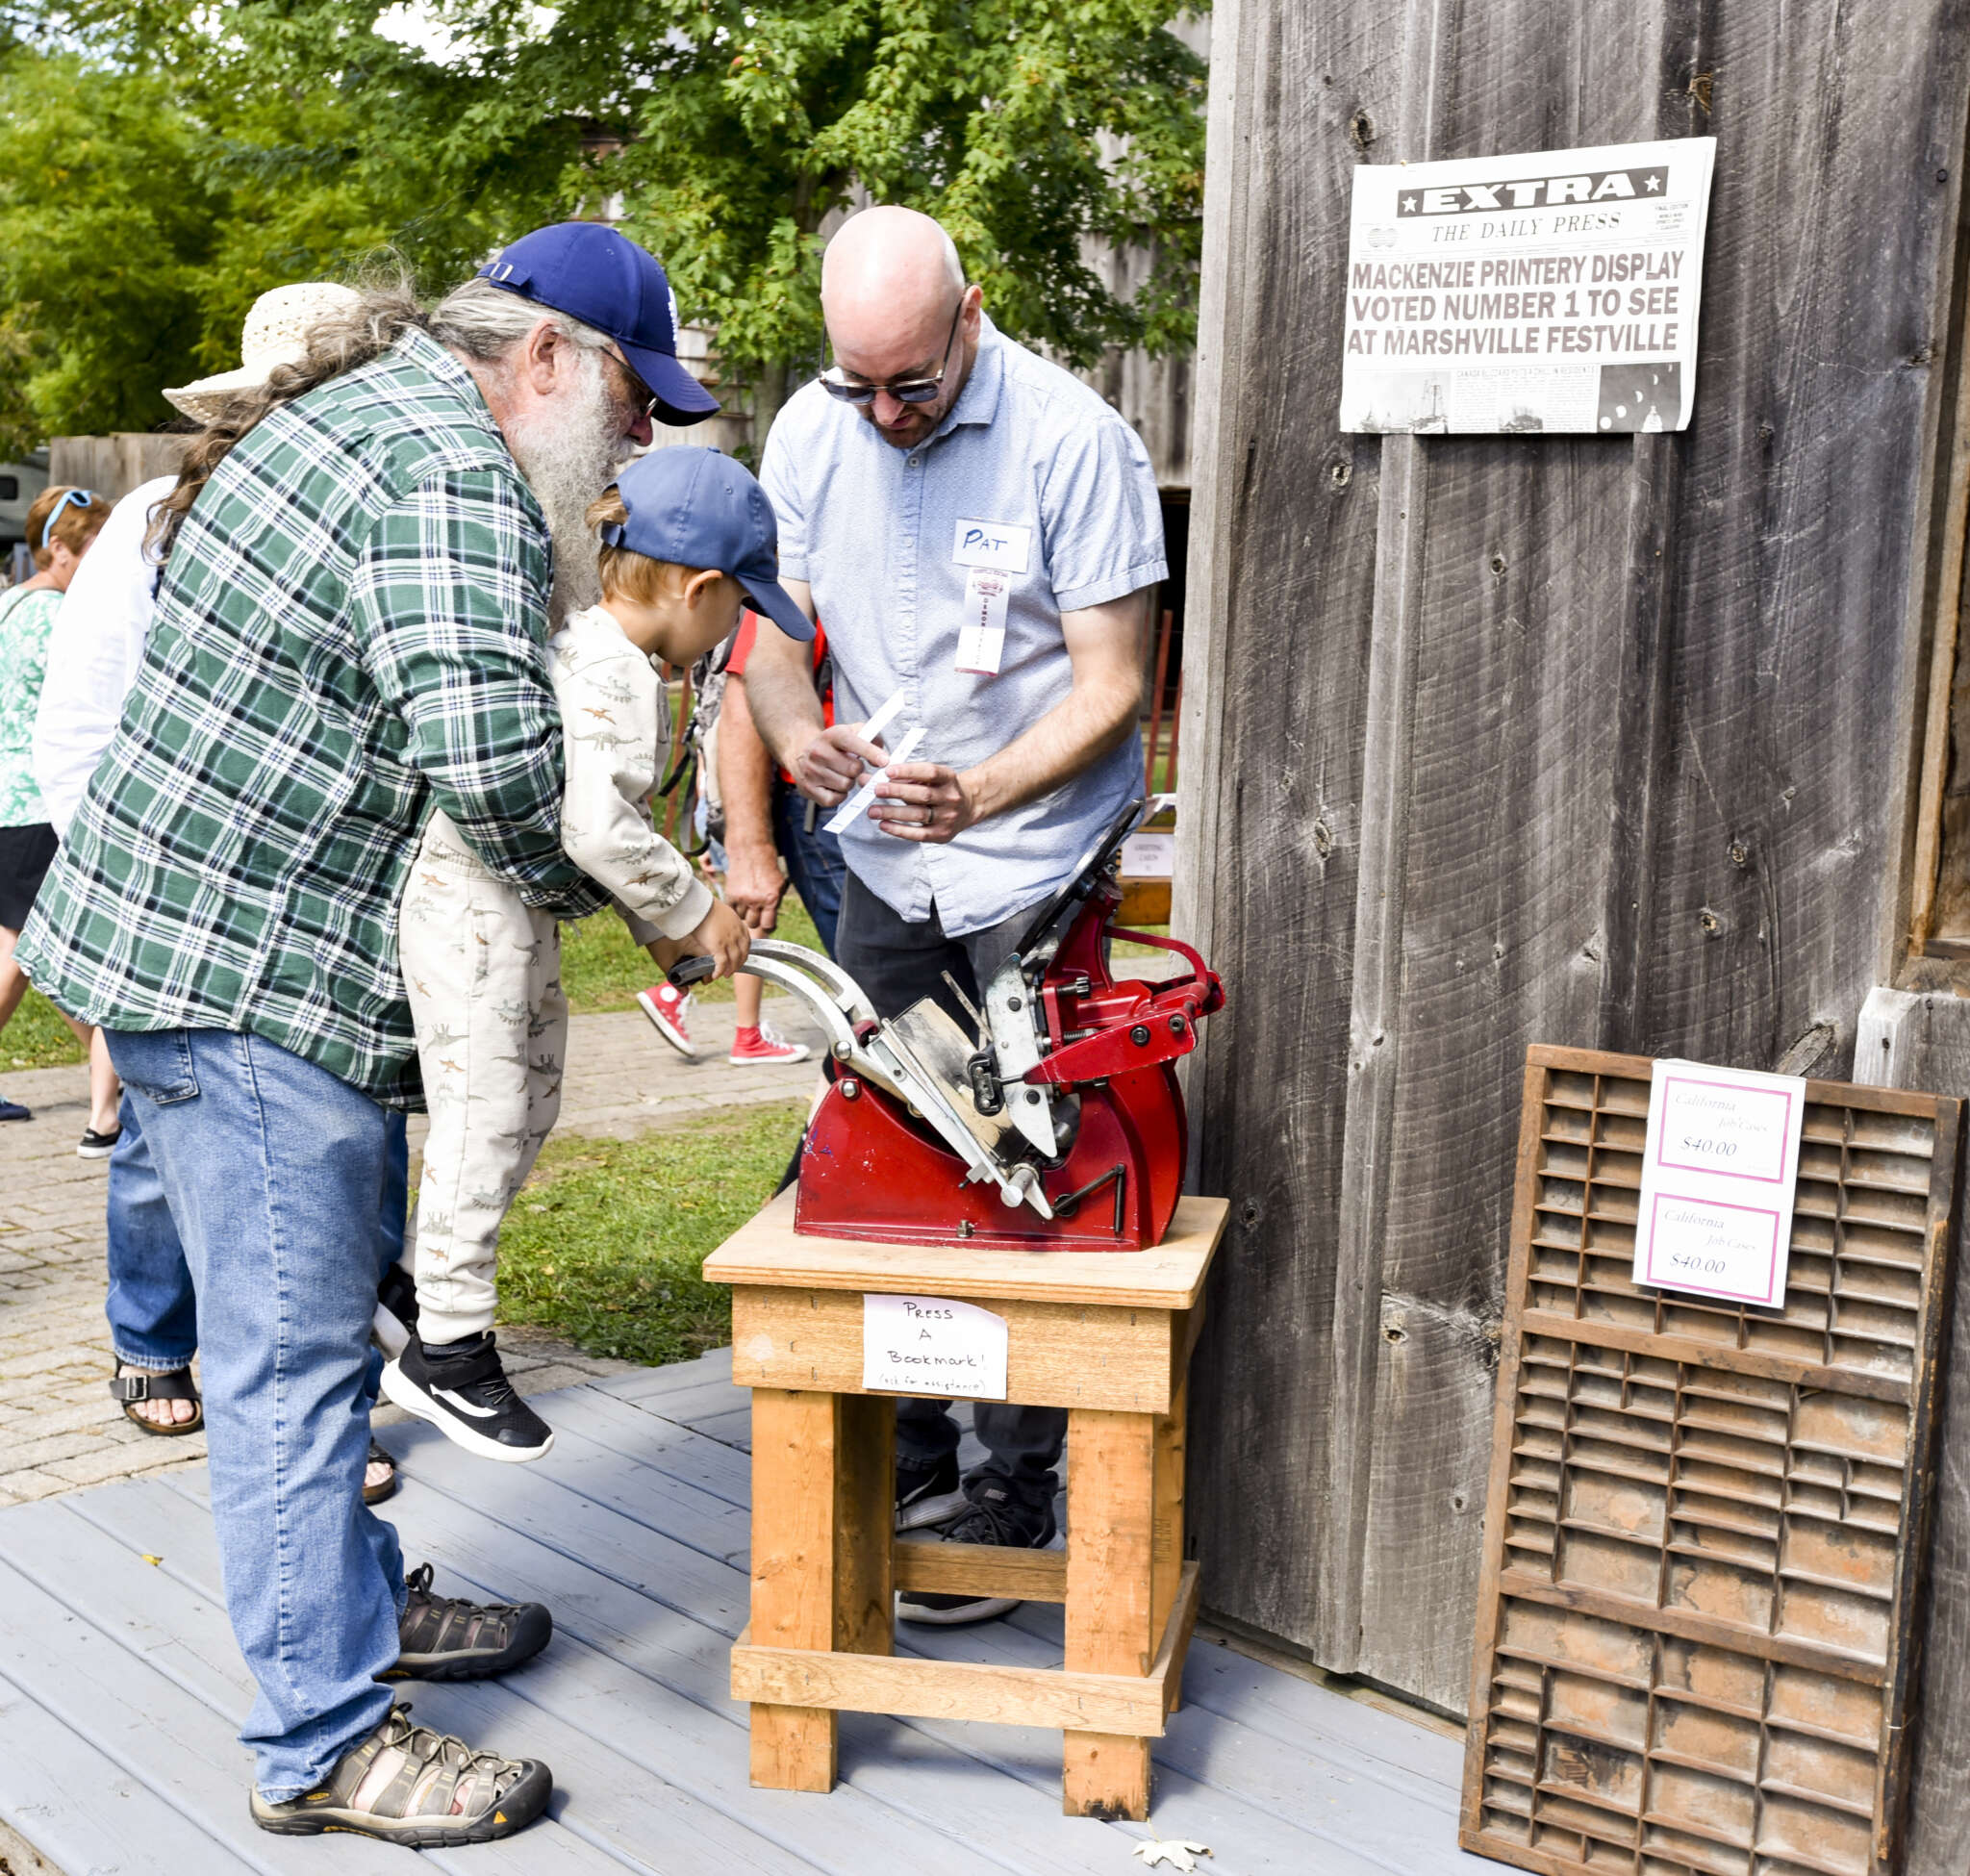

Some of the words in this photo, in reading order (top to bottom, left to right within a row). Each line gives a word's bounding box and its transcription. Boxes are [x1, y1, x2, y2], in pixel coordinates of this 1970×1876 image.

[1422, 172, 1636, 214] EXTRA
[1432, 223, 1470, 242] THE
[1479, 217, 1542, 239] DAILY
[1553, 212, 1622, 233] PRESS
[1351, 261, 1476, 290] MACKENZIE
[1479, 255, 1587, 287] PRINTERY
[1591, 250, 1684, 283] DISPLAY
[1351, 295, 1436, 322] VOTED
[1443, 292, 1555, 321] NUMBER
[1564, 293, 1579, 317] 1
[1587, 289, 1622, 317] TO
[1628, 286, 1679, 316] SEE
[1347, 329, 1377, 355] AT
[1384, 327, 1539, 355] MARSHVILLE
[1546, 322, 1678, 353] FESTVILLE
[1675, 1093, 1736, 1112] California
[1681, 1136, 1738, 1157] $40.00
[1664, 1208, 1725, 1230] California
[1670, 1252, 1727, 1274] $40.00
[919, 1329, 932, 1340] A
[887, 1350, 987, 1370] Bookmark!
